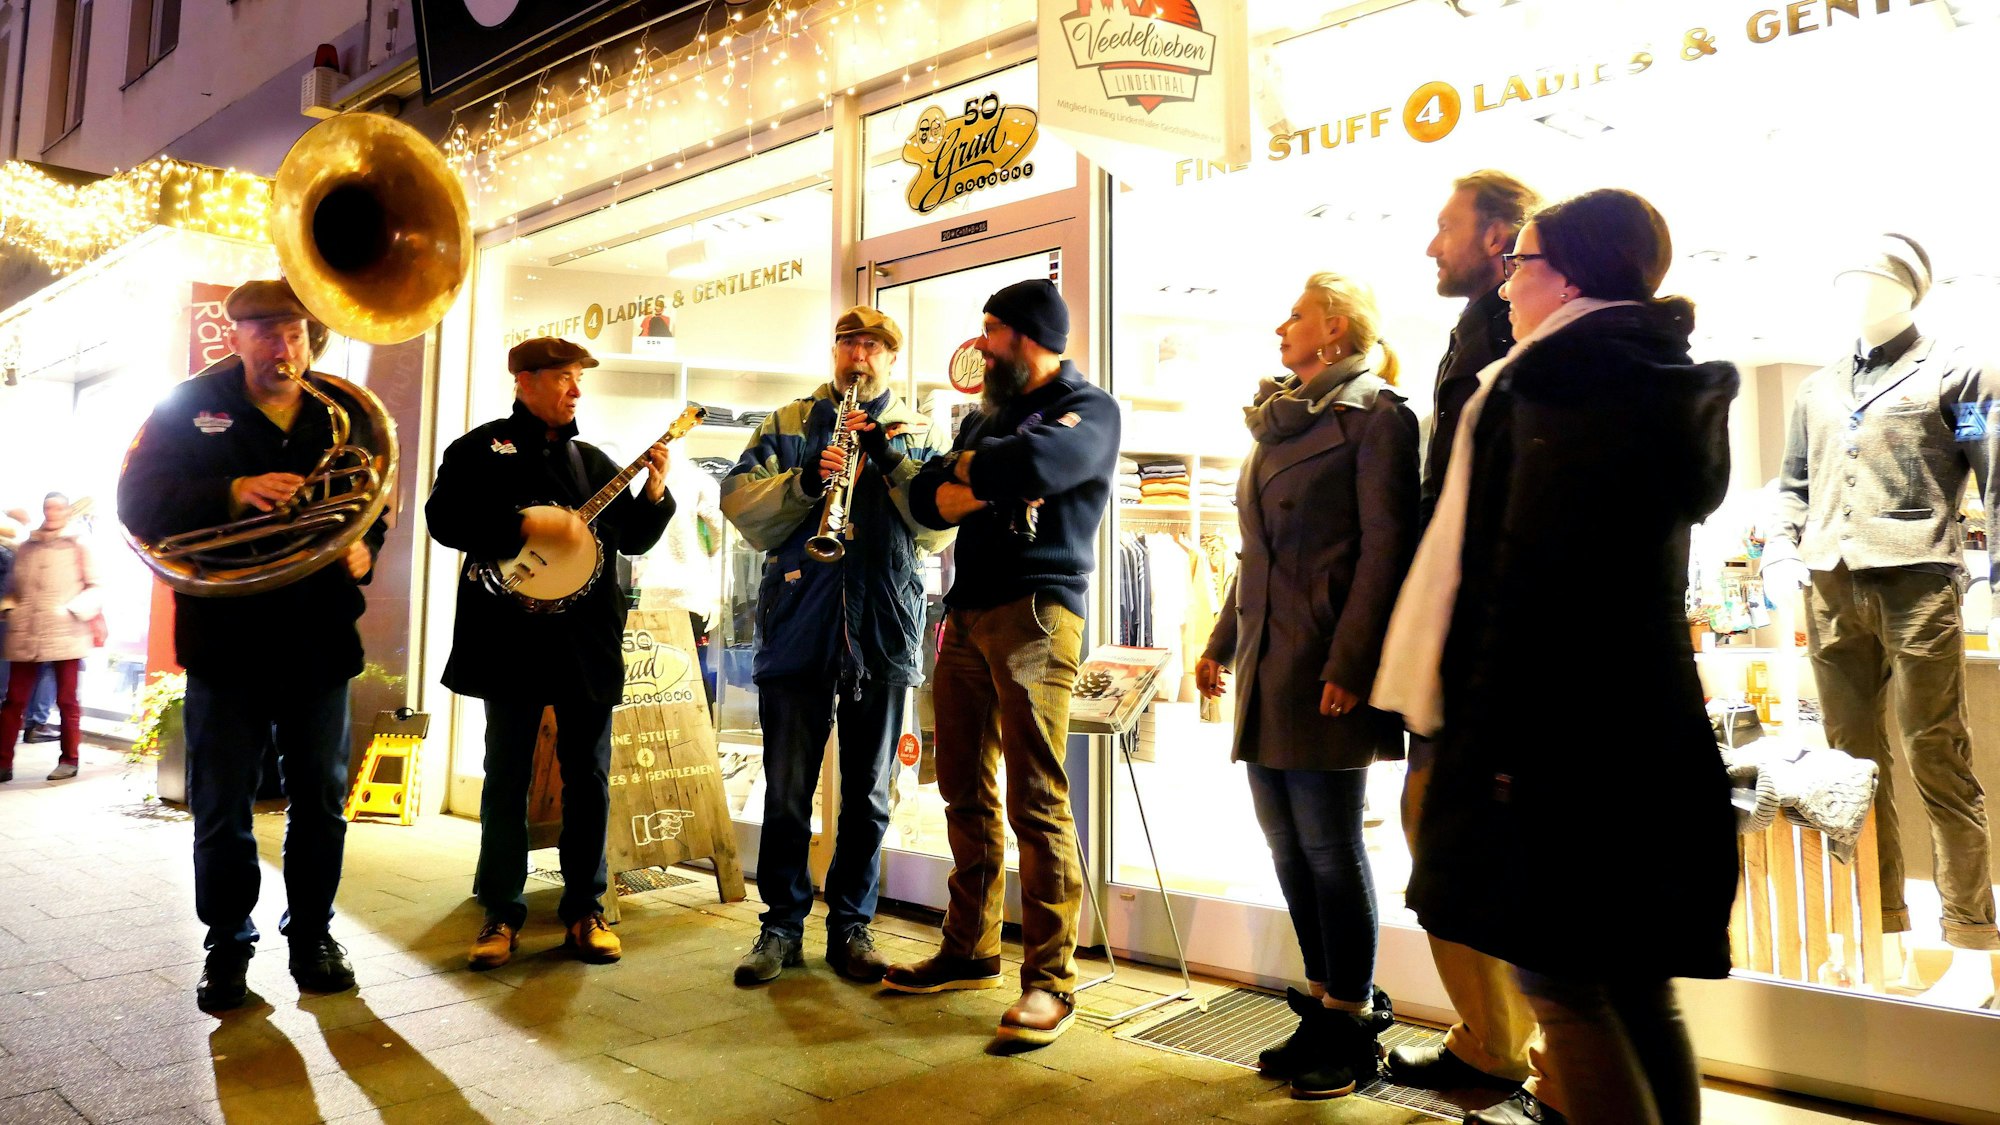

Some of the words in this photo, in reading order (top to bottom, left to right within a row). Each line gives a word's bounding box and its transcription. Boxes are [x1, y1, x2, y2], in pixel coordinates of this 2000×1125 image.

[1114, 74, 1185, 94] LINDENTHAL
[1267, 106, 1392, 161] STUFF
[1679, 27, 1718, 61] &
[964, 93, 999, 126] 50
[1056, 99, 1087, 112] Mitglied
[1088, 105, 1098, 115] im
[1099, 108, 1116, 121] Ring
[918, 105, 1007, 213] Grad
[955, 163, 1034, 196] COLOGNE
[537, 316, 582, 337] STUFF
[672, 289, 684, 308] &
[692, 258, 803, 304] GENTLEMEN
[192, 301, 229, 365] Räu
[622, 690, 693, 705] COLOGNE
[638, 729, 680, 743] STUFF
[631, 773, 642, 784] &
[645, 764, 716, 782] GENTLEMEN
